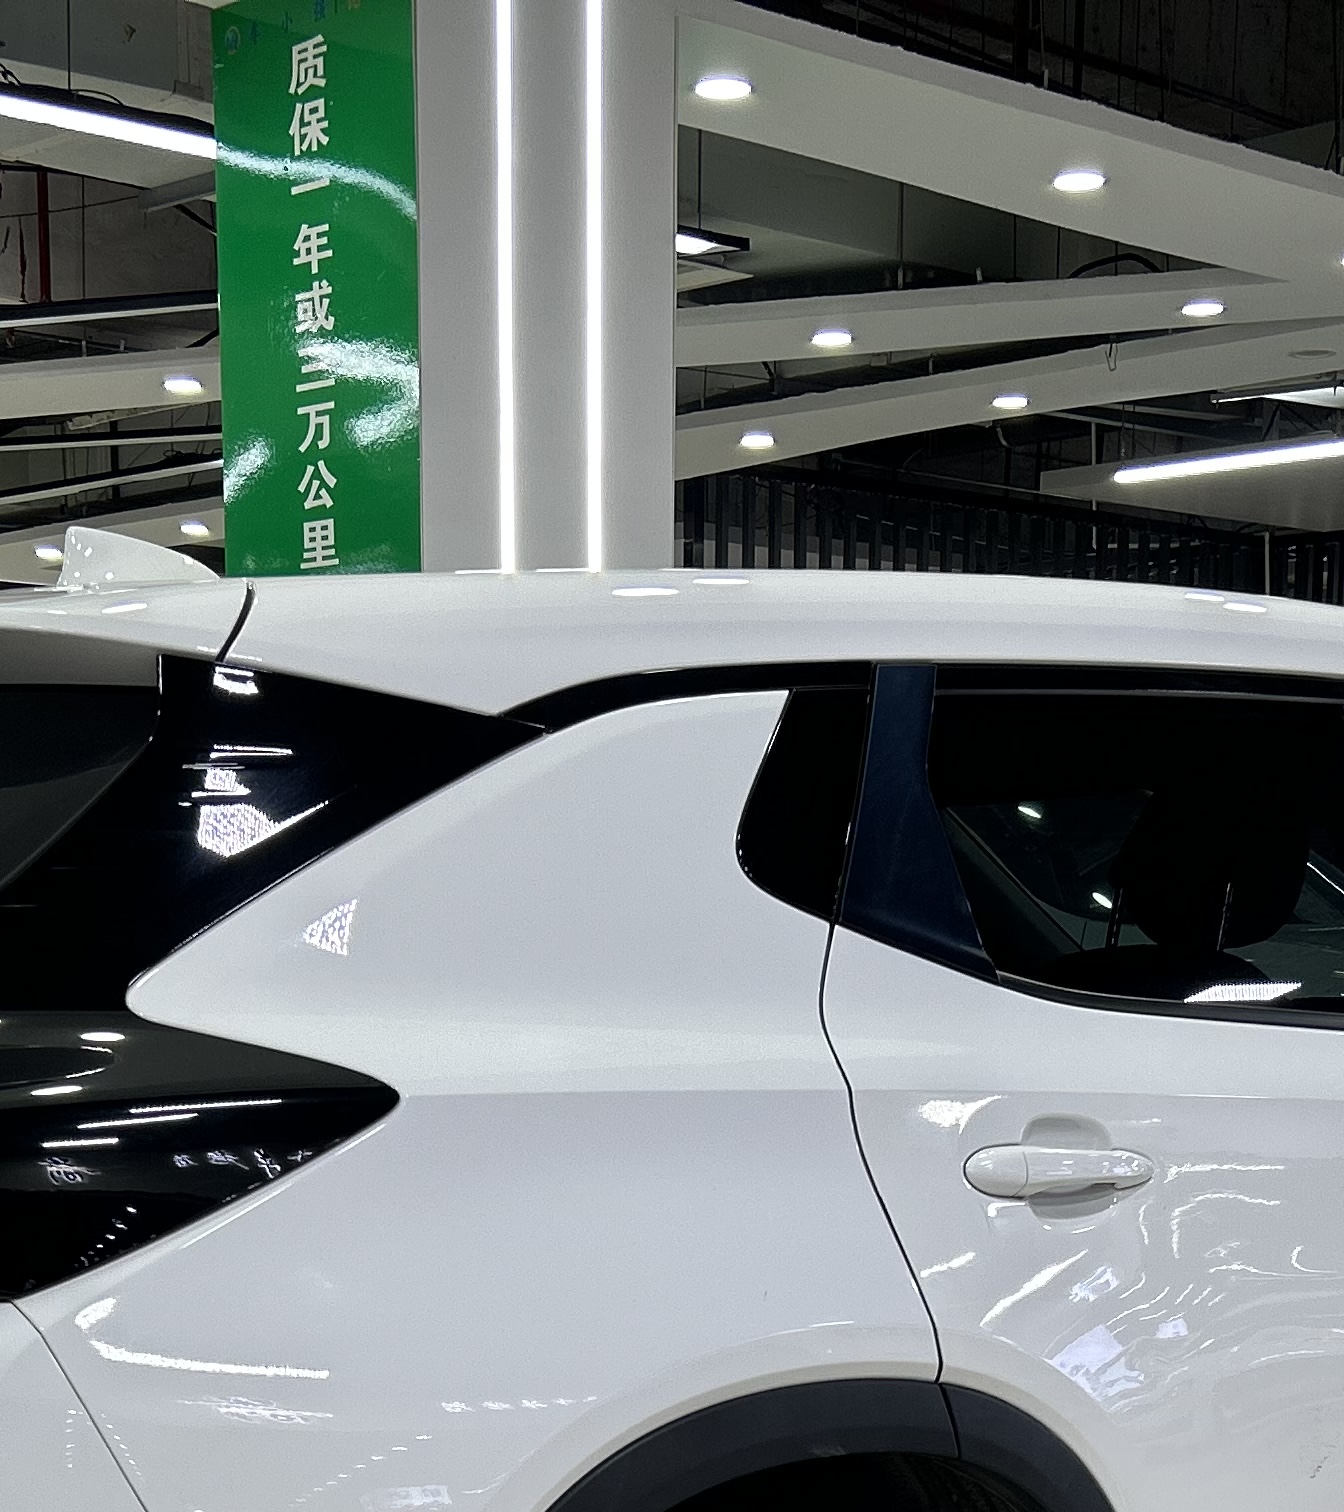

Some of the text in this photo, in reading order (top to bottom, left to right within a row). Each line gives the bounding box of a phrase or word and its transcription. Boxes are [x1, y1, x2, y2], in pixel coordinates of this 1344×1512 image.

[288, 34, 340, 571] 质保一年或三万公里
